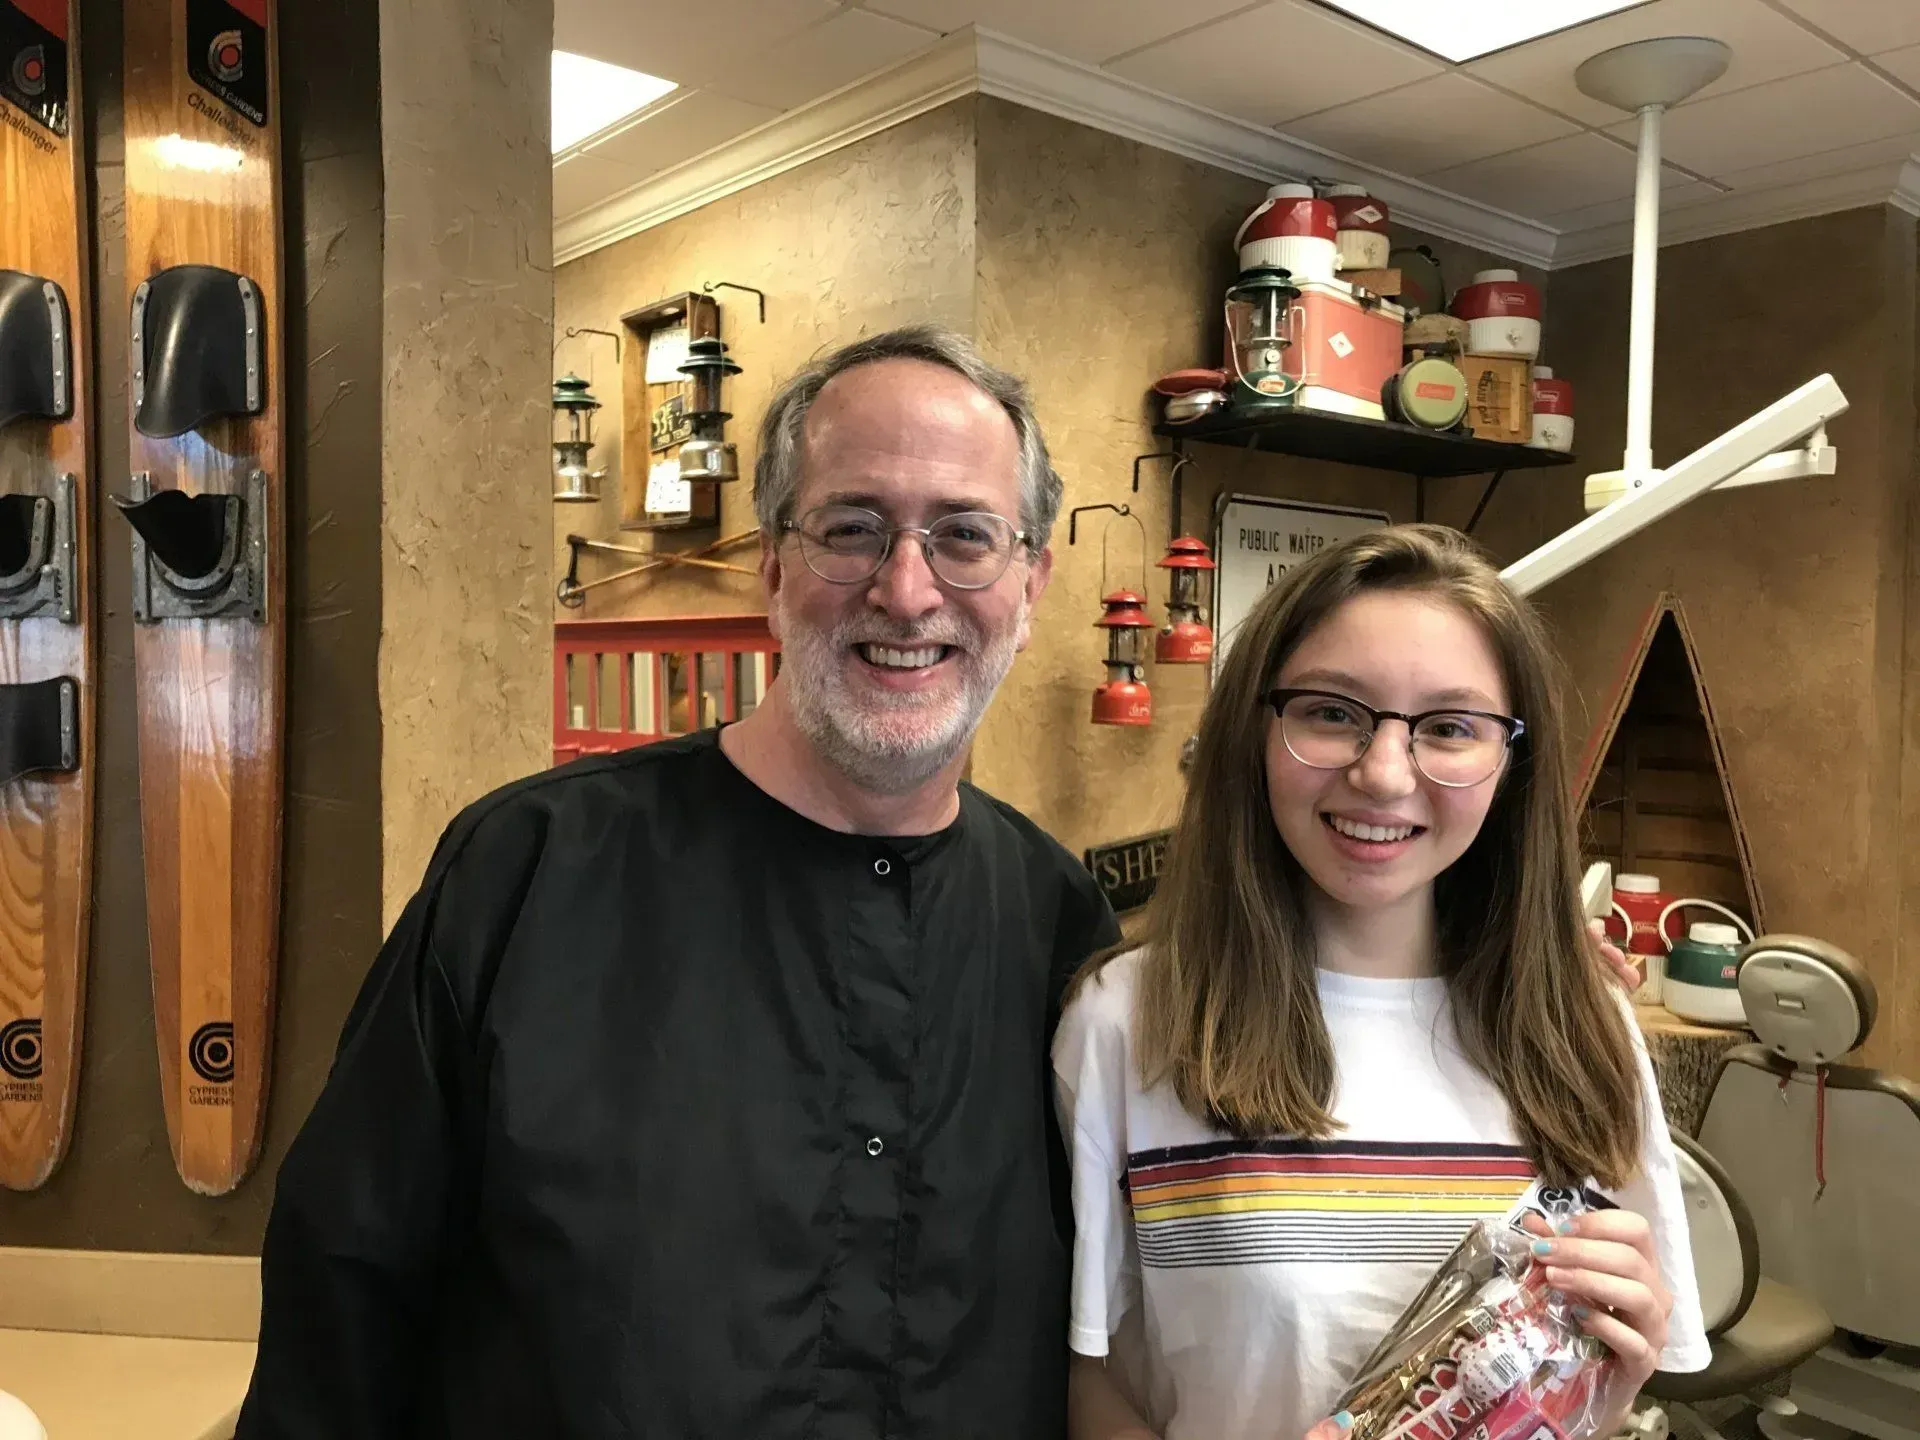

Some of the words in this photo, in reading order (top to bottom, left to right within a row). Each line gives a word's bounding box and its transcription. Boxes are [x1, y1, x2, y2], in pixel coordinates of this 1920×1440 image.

[188, 92, 256, 147] Challenger
[1239, 528, 1280, 552] PUBLIC
[189, 1085, 235, 1096] CYPRESS
[189, 1096, 235, 1106] GARDENS
